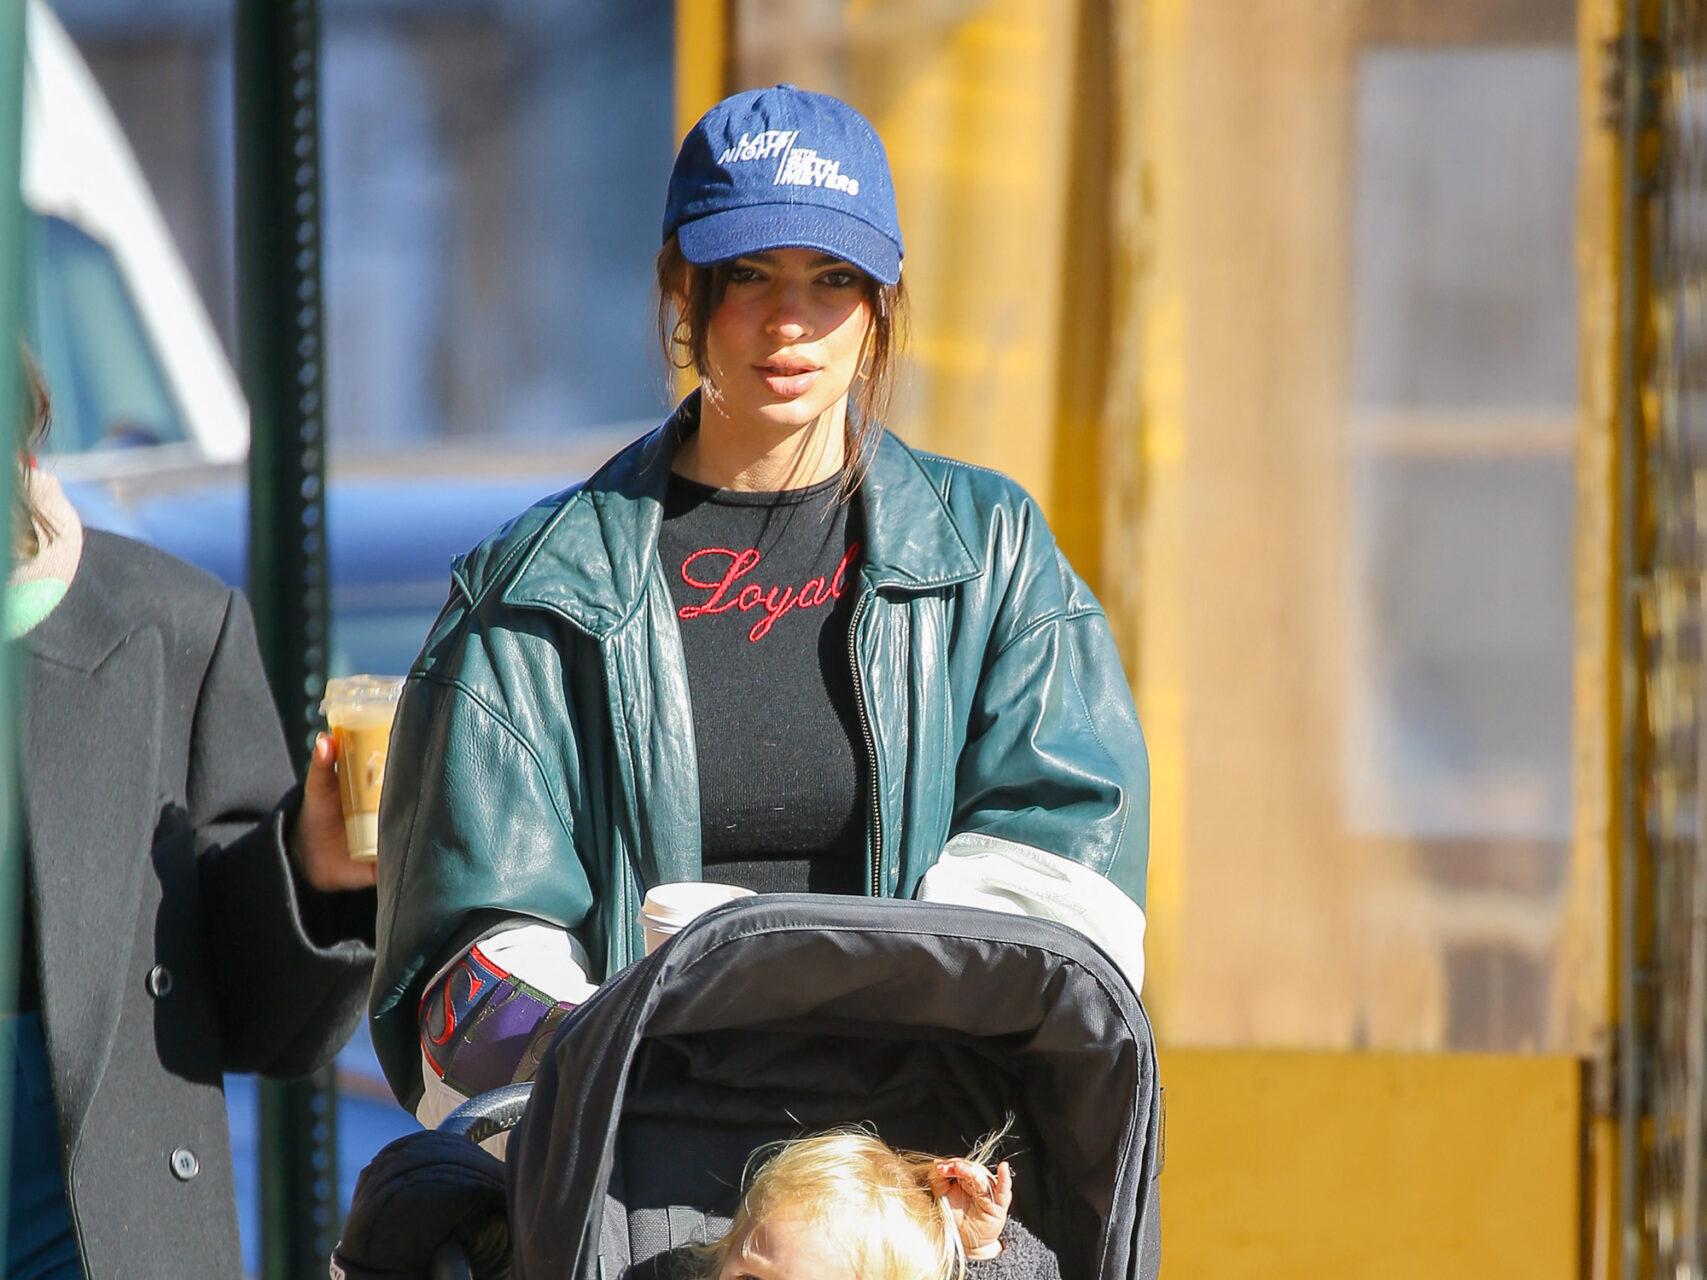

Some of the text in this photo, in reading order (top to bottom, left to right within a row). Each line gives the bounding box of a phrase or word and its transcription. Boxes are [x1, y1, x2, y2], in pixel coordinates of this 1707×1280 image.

[738, 130, 792, 147] LATE
[717, 143, 786, 165] NIGHT
[786, 155, 841, 176] SETH
[780, 171, 859, 195] MEYERS
[678, 544, 860, 643] Loyal
